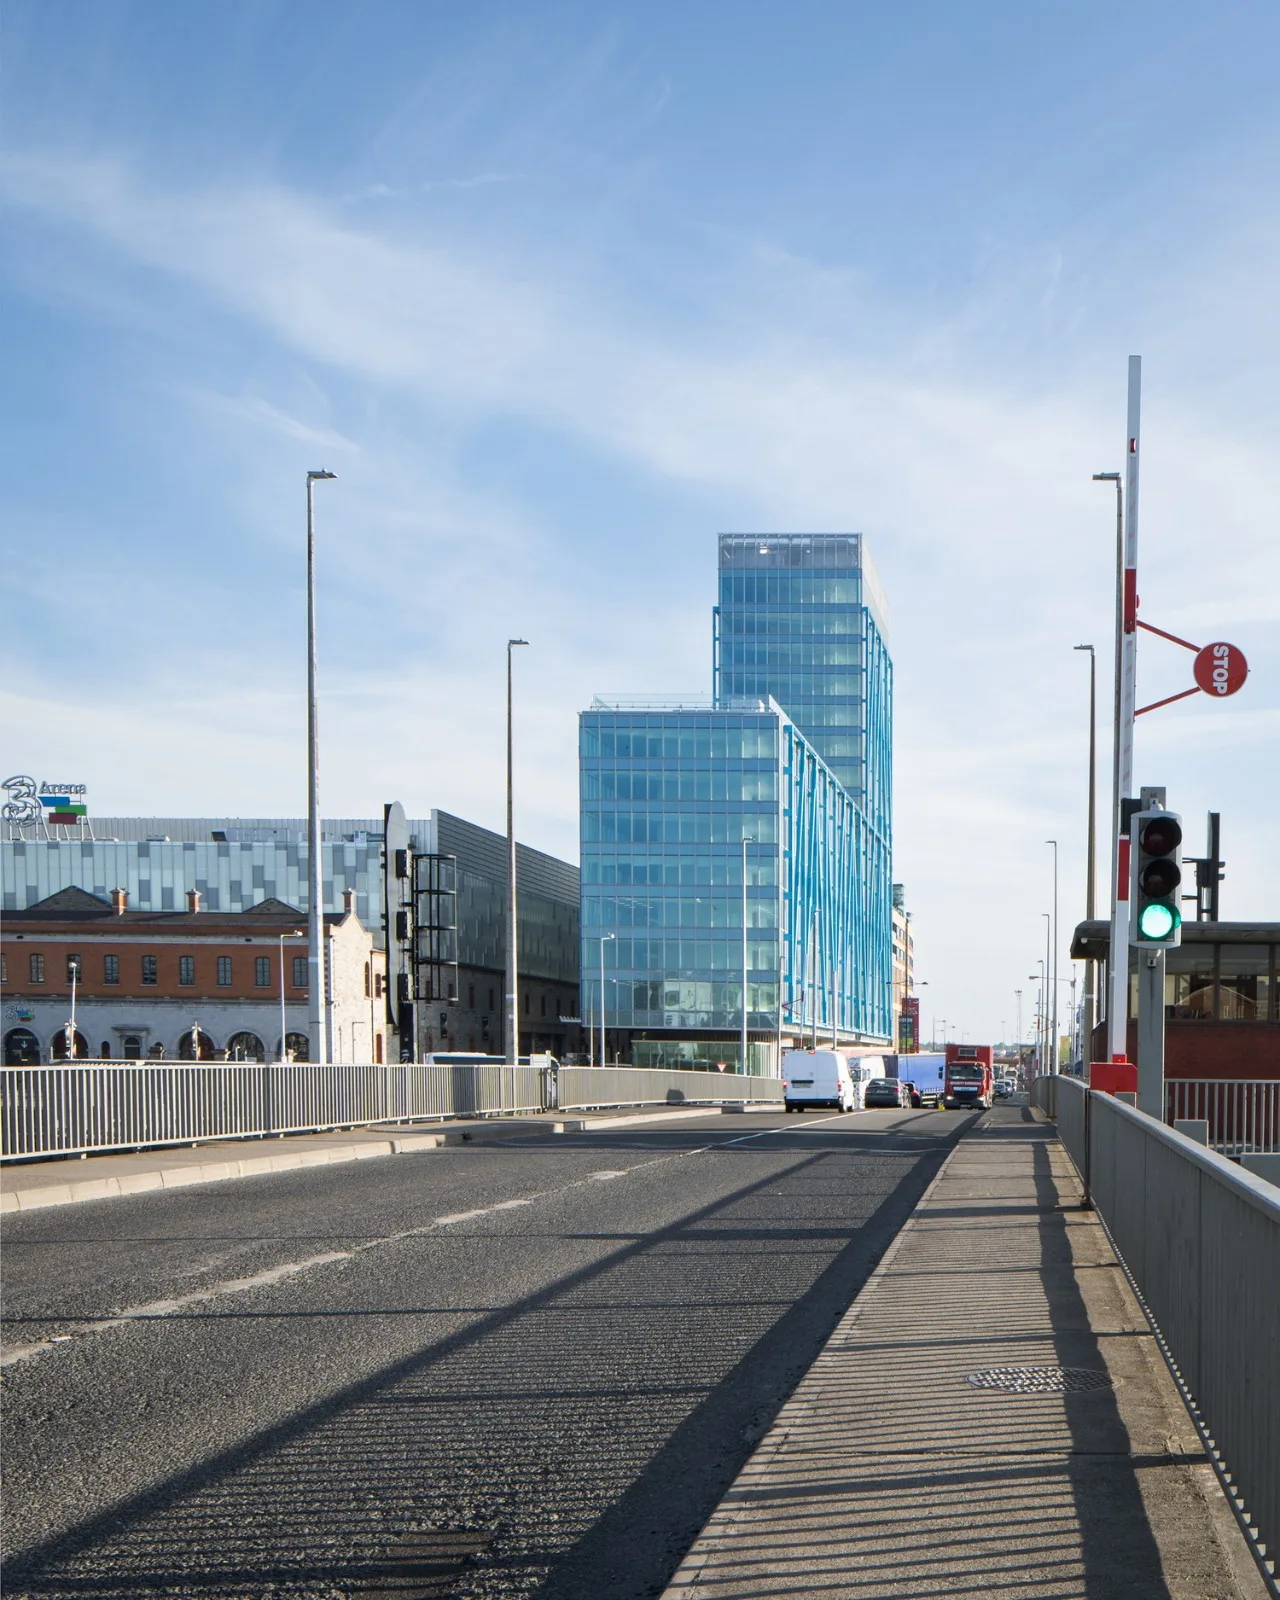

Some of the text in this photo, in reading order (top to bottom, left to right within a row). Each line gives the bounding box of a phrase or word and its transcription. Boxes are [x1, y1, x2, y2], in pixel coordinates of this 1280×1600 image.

[1213, 645, 1229, 694] STOP
[1, 775, 87, 828] 3 Arena
